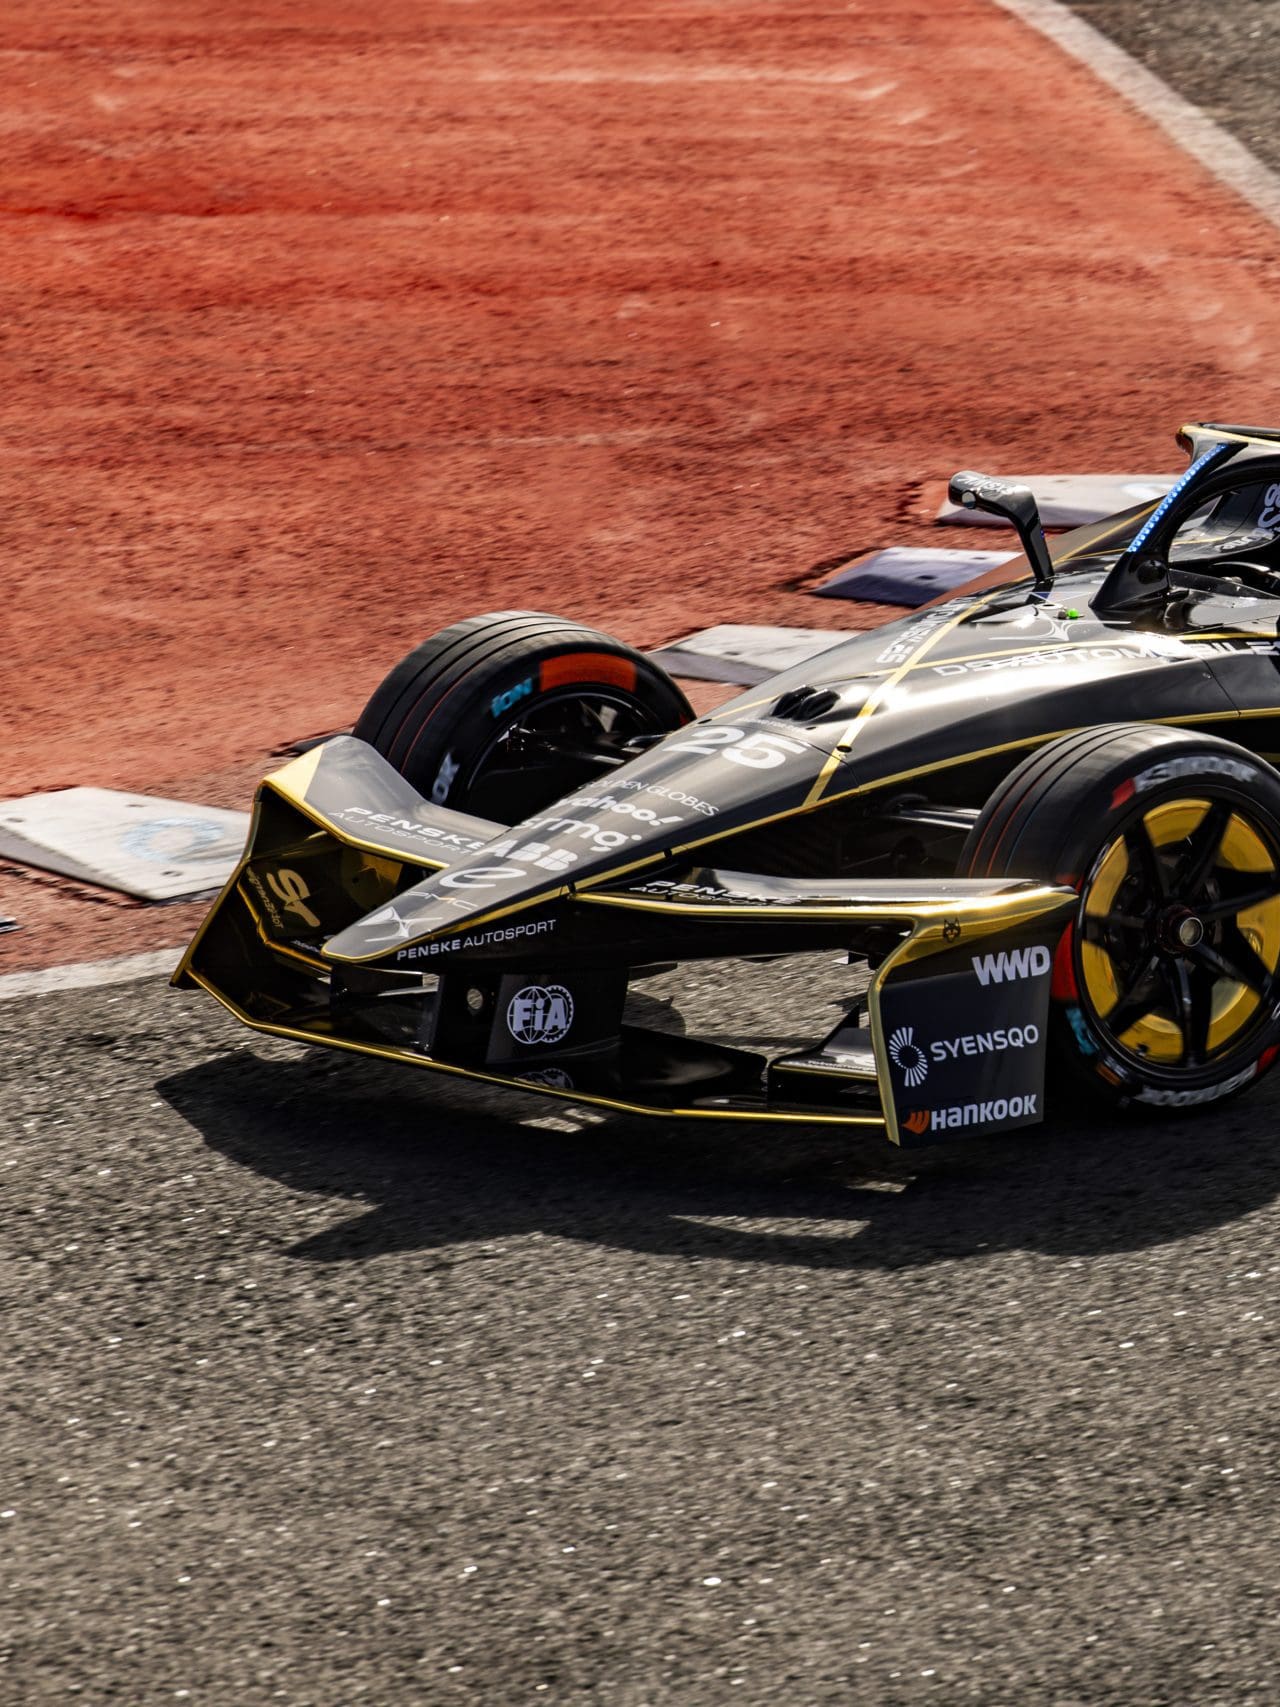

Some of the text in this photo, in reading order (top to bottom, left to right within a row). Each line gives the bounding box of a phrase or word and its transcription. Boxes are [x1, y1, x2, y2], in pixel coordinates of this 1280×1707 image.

[661, 726, 807, 770] 25
[646, 784, 720, 817] GLOBES
[327, 811, 475, 856] AUTOSPORT
[343, 806, 485, 850] PENSKE
[471, 839, 579, 871] ABB
[396, 919, 557, 961] PENSKE AUTOSPORT
[971, 945, 1051, 986] WWD
[930, 1024, 1039, 1062] SYENSQO
